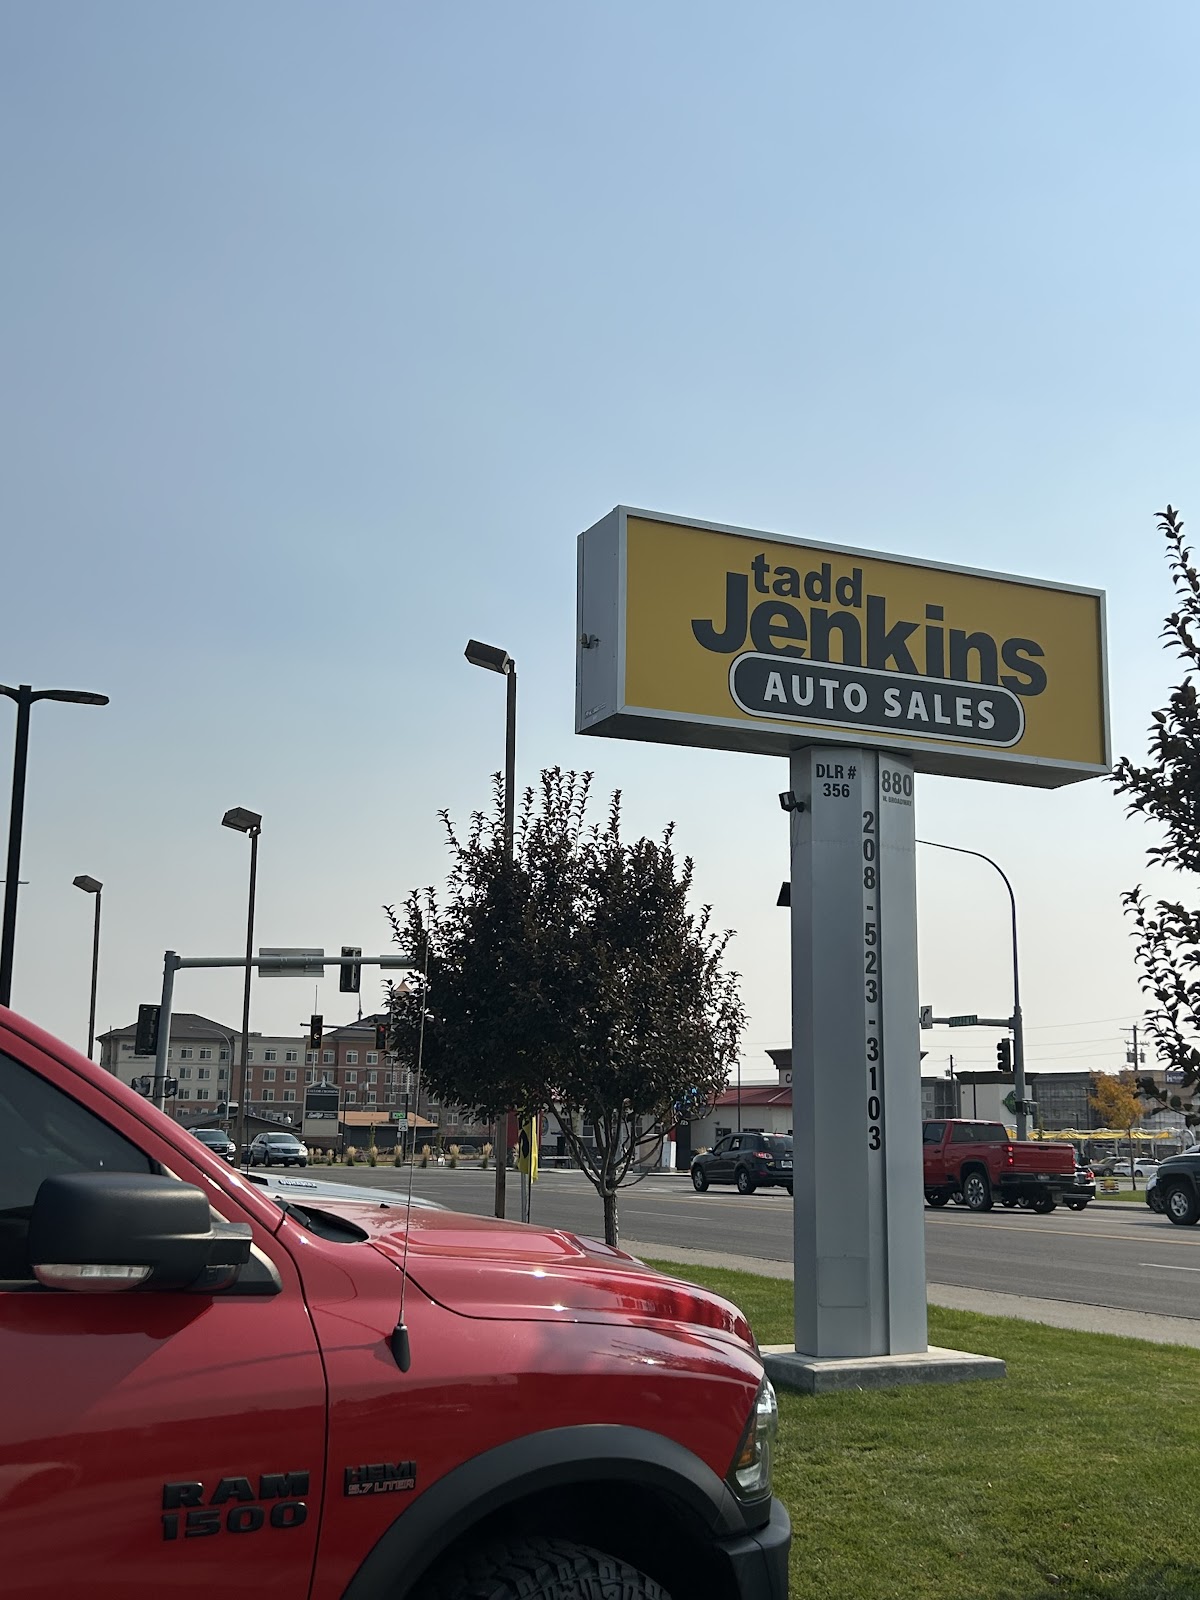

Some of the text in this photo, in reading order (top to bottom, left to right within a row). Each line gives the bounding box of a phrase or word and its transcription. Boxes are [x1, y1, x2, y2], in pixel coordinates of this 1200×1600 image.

[751, 553, 862, 608] tadd
[691, 572, 1047, 696] Jenkins
[763, 671, 996, 730] AUTO SALES
[815, 763, 857, 780] DLR #
[881, 769, 913, 797] 880
[822, 782, 850, 798] 356
[345, 1461, 416, 1484] HEMI
[347, 1478, 415, 1496] 5.7 LITER
[162, 1471, 310, 1510] RAM
[161, 1501, 308, 1541] 1500
